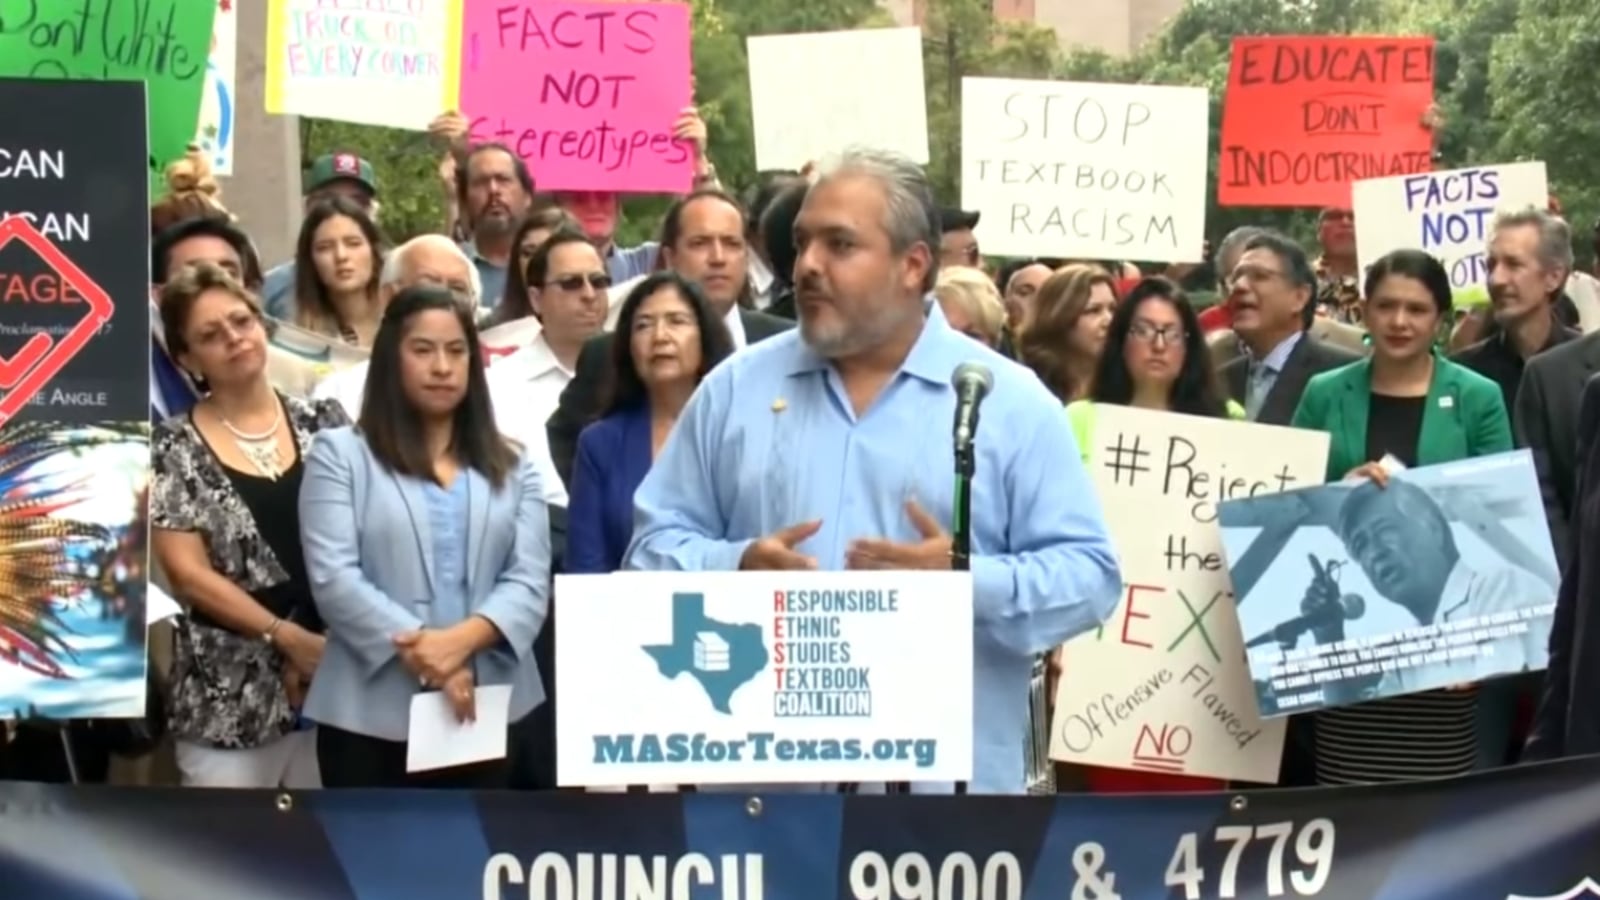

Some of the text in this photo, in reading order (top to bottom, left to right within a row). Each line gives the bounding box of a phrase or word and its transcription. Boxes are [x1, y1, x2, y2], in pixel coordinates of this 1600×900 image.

[101, 0, 199, 80] White
[293, 9, 378, 43] TRUCK
[497, 6, 658, 54] FACTS
[288, 43, 440, 80] EVERY CORNER
[1239, 43, 1433, 86] EDUCATE!
[540, 69, 637, 109] NOT
[1002, 91, 1152, 147] STOP
[1301, 99, 1386, 133] DON'T
[976, 158, 1175, 199] TEXTBOOK
[1404, 170, 1499, 212] FACTS
[1009, 202, 1179, 248] RACISM
[1421, 207, 1494, 249] NOT
[51, 387, 108, 406] ANGLE
[1163, 534, 1223, 571] the
[773, 589, 899, 613] RESPONSIBLE
[773, 615, 841, 638] ETHNIC
[773, 641, 852, 664] STUDIES
[773, 667, 871, 690] TEXTBOOK
[776, 692, 870, 716] COALITION
[1061, 667, 1173, 753] Offensive
[1180, 663, 1261, 750] Flawed
[593, 732, 937, 768] MASforTexas.org
[1133, 723, 1193, 756] NO
[848, 850, 1024, 900] 9900
[1070, 841, 1122, 900] &
[1163, 817, 1337, 900] 4779
